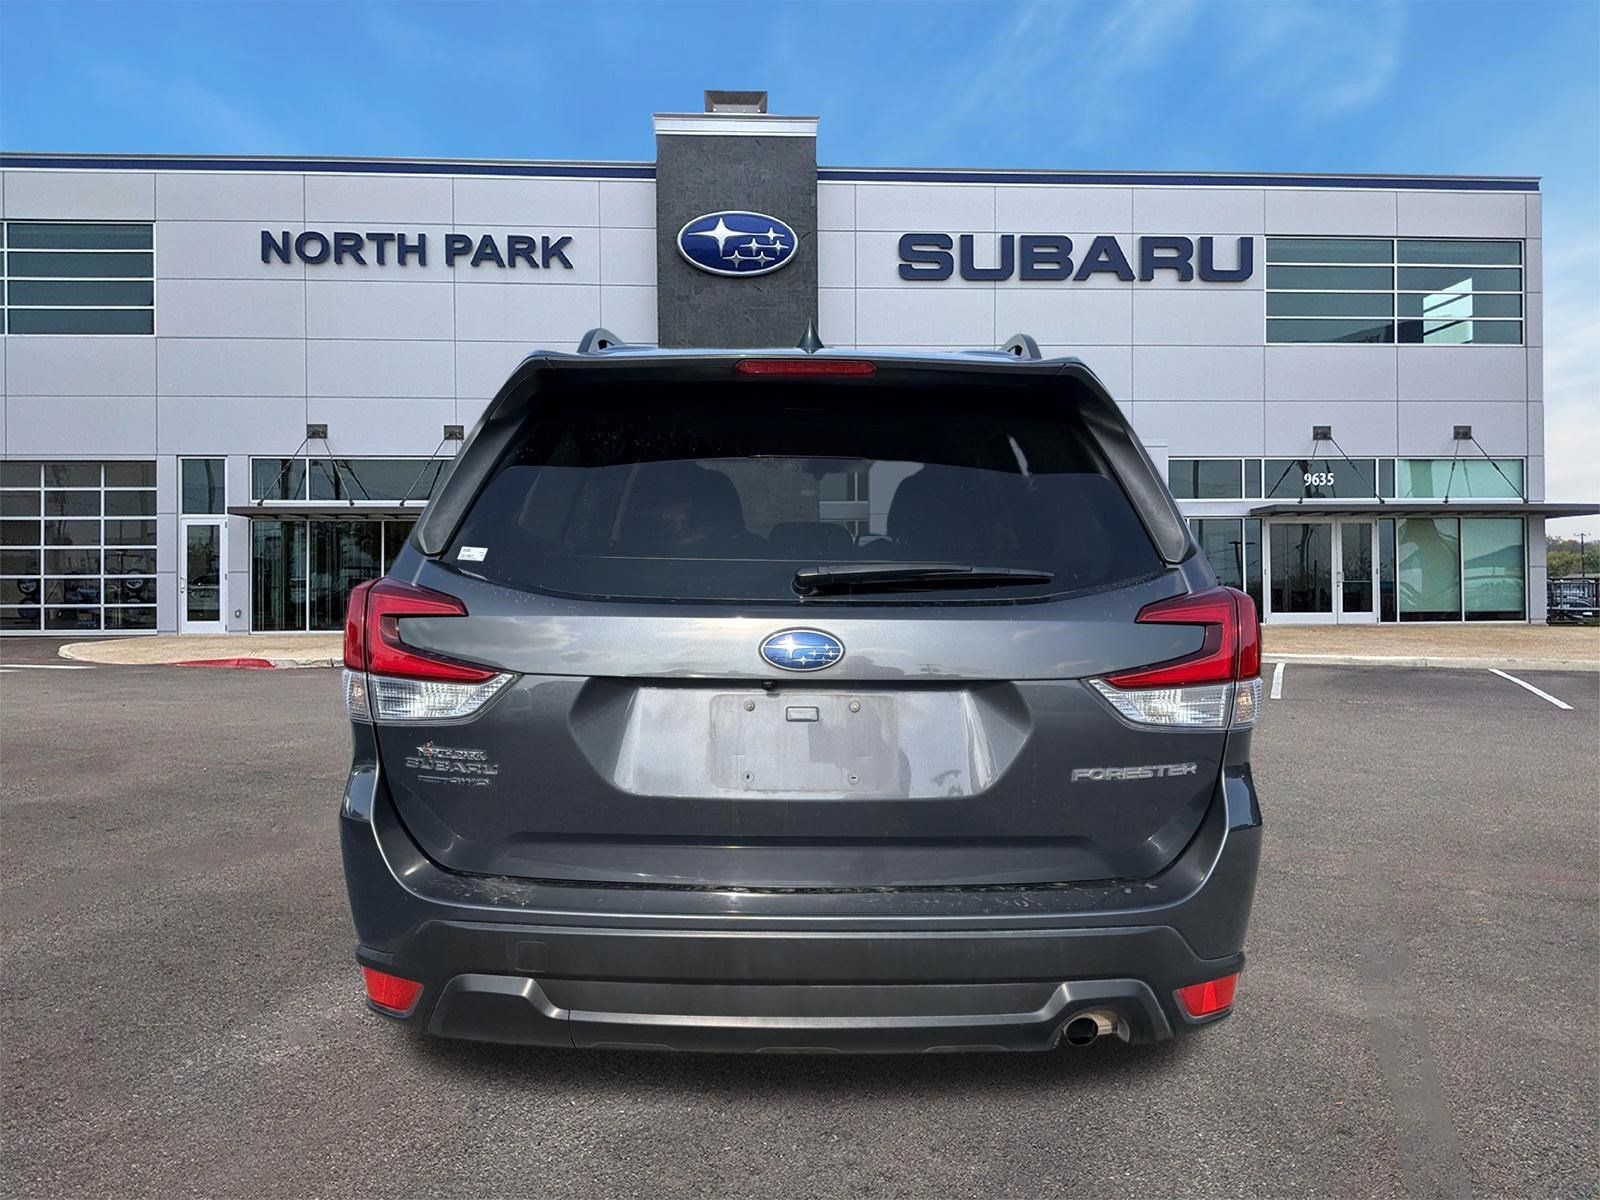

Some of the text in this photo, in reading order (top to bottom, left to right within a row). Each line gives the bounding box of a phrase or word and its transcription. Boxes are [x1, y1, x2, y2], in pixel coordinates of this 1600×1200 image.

[261, 230, 574, 269] NORTH PARK
[898, 233, 1254, 282] SUBARU
[1304, 472, 1335, 486] 9635
[405, 757, 499, 775] SUBARU
[1071, 762, 1197, 782] FORESTER
